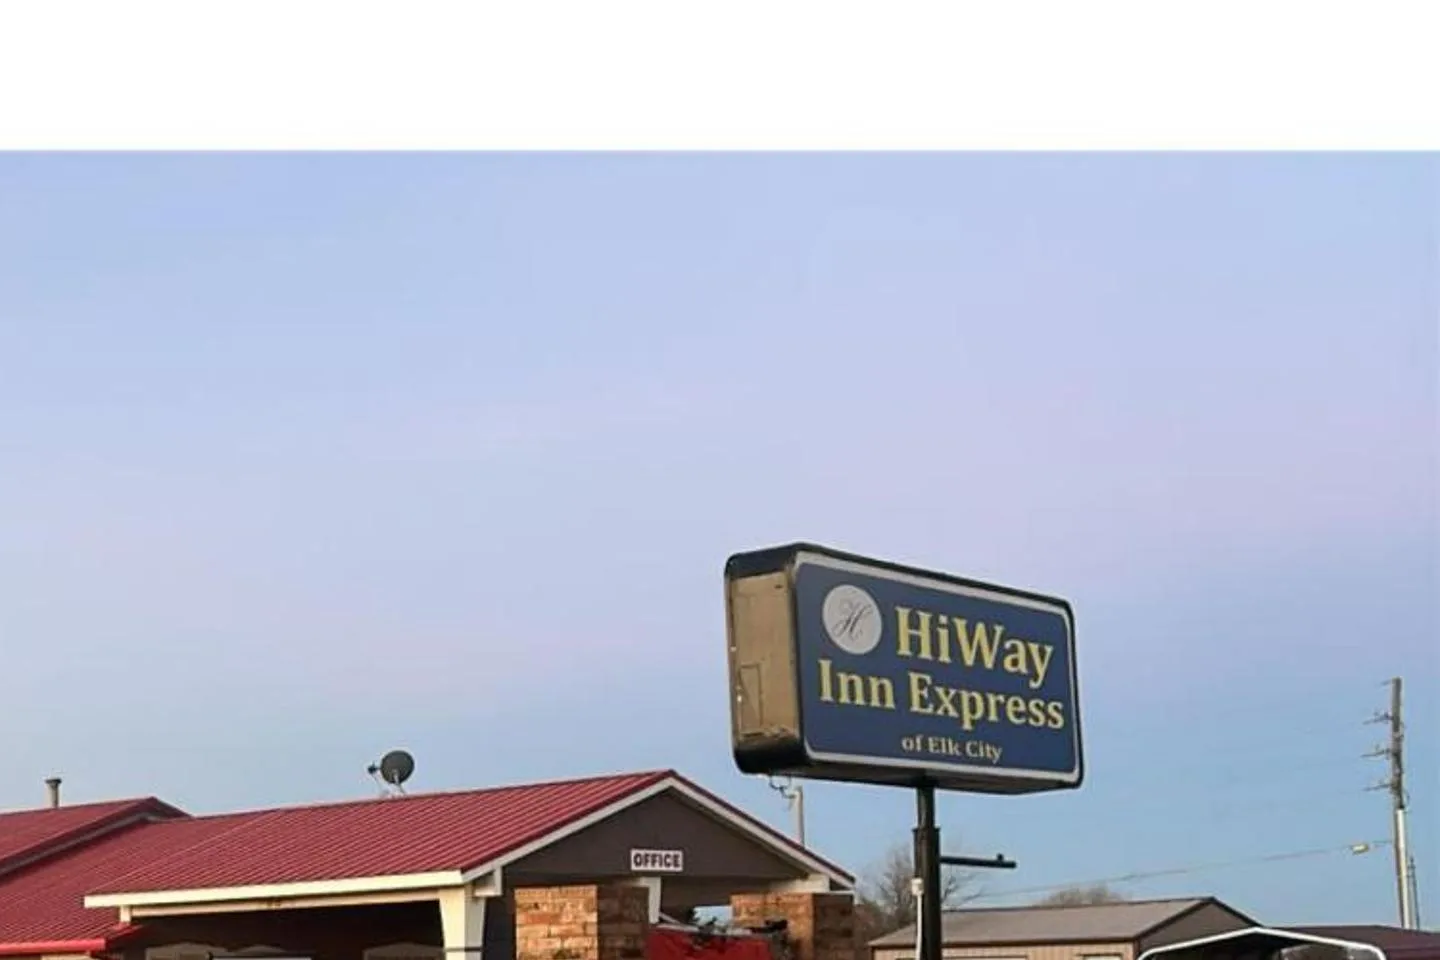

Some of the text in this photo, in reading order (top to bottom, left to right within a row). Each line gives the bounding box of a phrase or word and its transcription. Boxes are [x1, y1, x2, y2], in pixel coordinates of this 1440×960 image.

[894, 606, 1055, 689] HiWay
[817, 659, 1066, 730] Inn Express
[901, 734, 1004, 765] of Elk City
[633, 852, 681, 868] OFFICE
